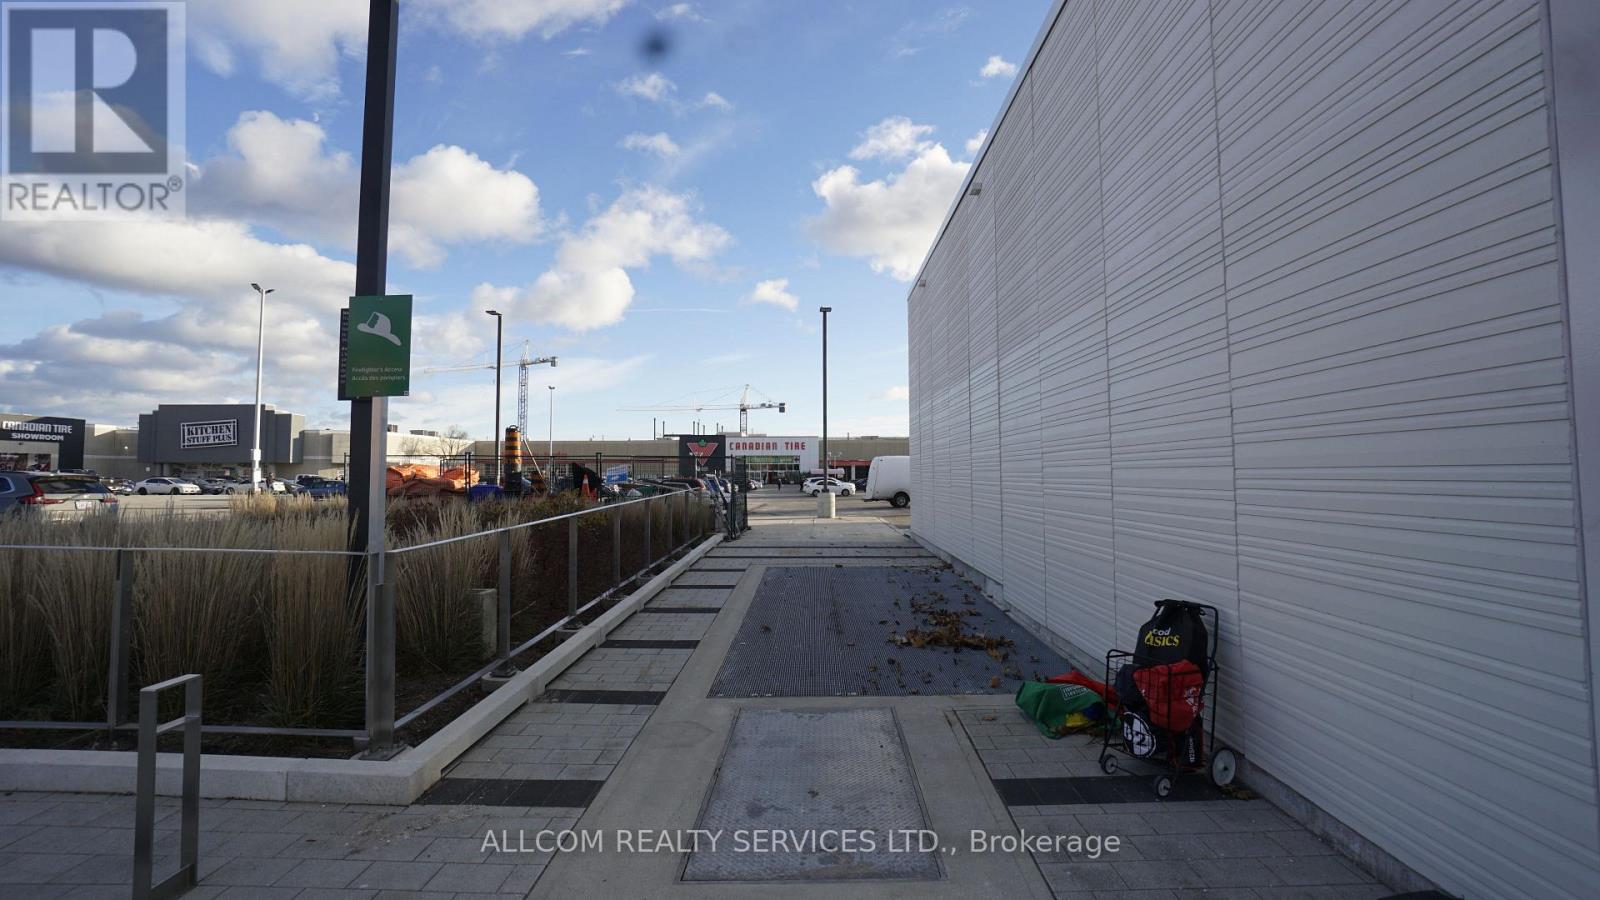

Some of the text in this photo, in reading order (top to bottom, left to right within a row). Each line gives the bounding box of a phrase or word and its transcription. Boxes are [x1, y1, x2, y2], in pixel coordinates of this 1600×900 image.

[2, 420, 73, 434] CANADIAN TIRE
[187, 424, 232, 436] KITCHEN
[11, 432, 65, 441] SHOWROOM
[186, 433, 233, 444] STUFF PLUS
[729, 441, 807, 451] CANADIAN TIRE
